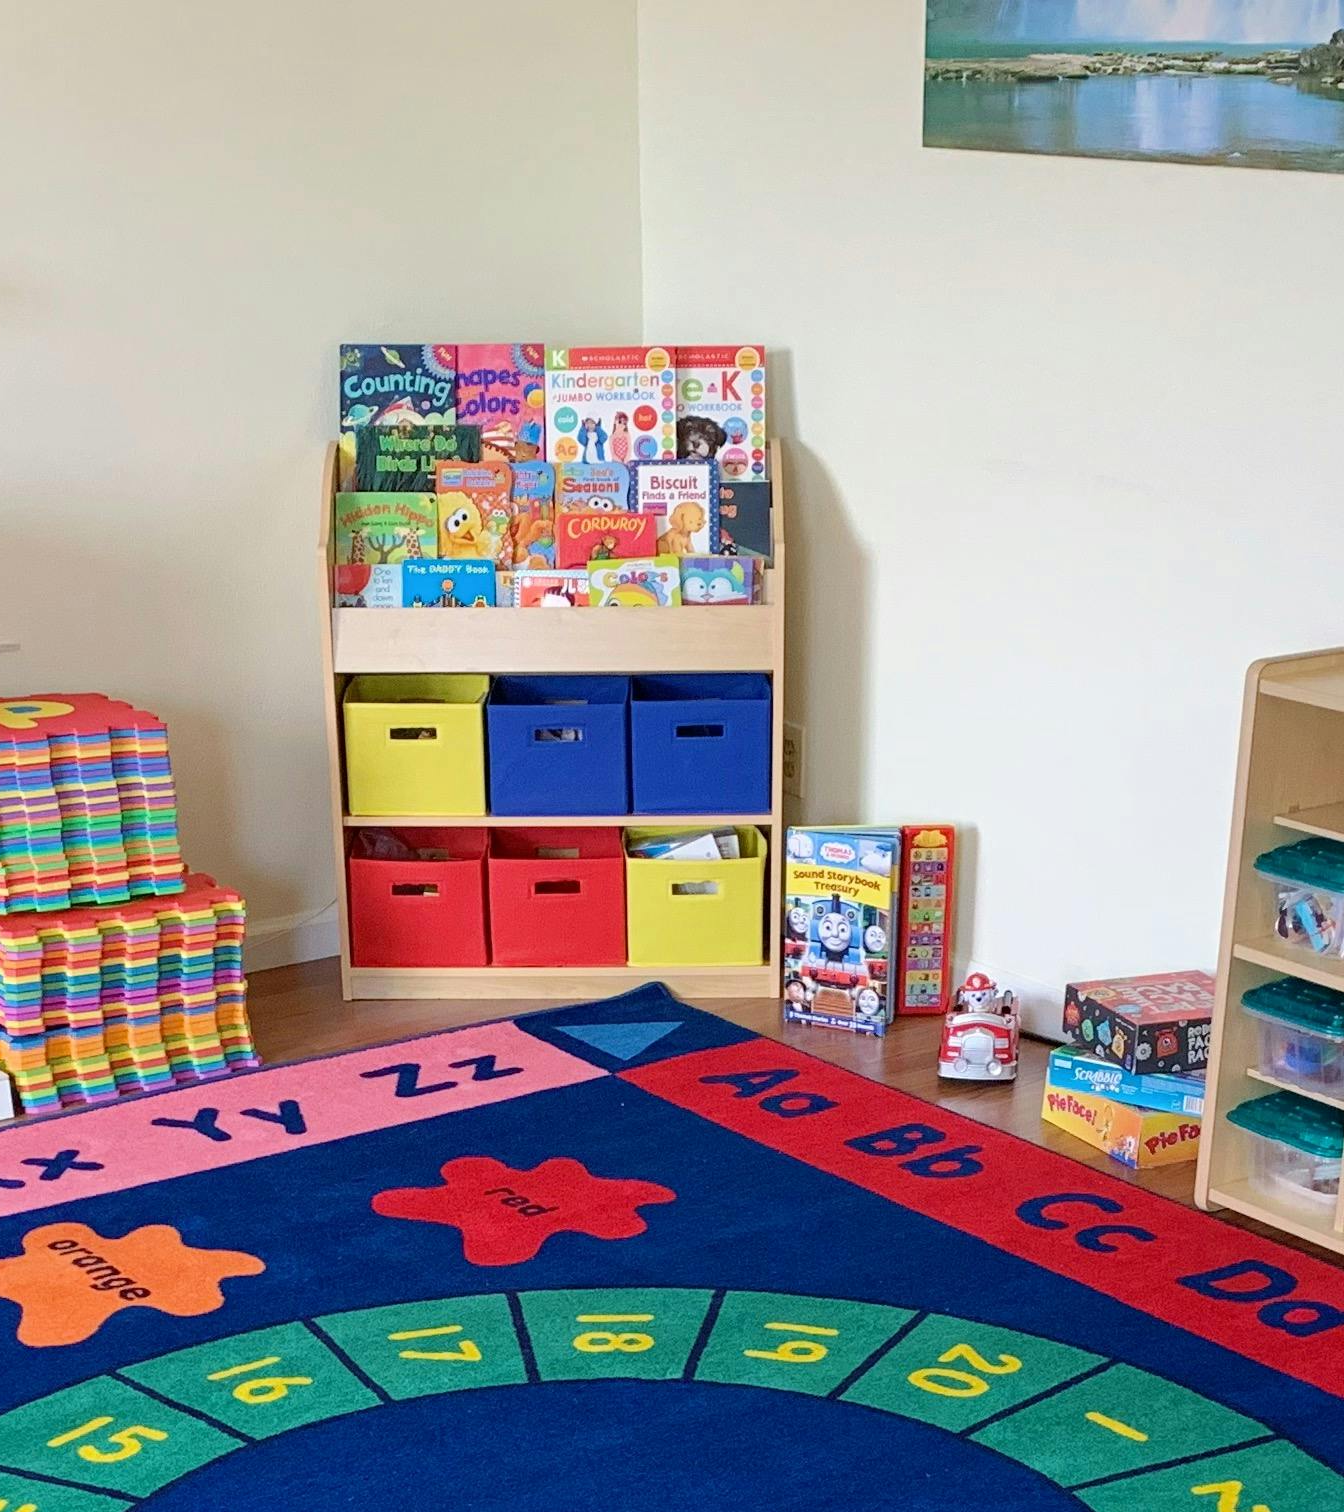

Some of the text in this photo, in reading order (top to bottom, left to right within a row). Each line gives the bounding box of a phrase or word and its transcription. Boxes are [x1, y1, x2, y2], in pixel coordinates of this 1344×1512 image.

[344, 367, 451, 407] Counting
[551, 372, 660, 391] Kindergarten
[556, 391, 656, 403] JUMBO WORKBOOK
[688, 403, 742, 411] WORKBOOK
[562, 477, 620, 492] Seasons
[642, 491, 666, 500] Finds
[678, 491, 706, 500] Friend
[650, 475, 698, 490] Biscuit
[567, 517, 647, 541] CORDUROY
[407, 565, 426, 574] The
[793, 869, 881, 891] Sound Storybook
[814, 882, 860, 896] Treasury
[1072, 1067, 1123, 1085] SCRABBLE
[152, 1100, 307, 1141] Yy
[360, 1055, 523, 1097] Zz
[700, 1069, 838, 1118] Aa
[845, 1124, 983, 1178] Bb
[1016, 1193, 1156, 1253] Cc
[484, 1184, 556, 1220] red
[47, 1237, 152, 1302] orange
[392, 1326, 480, 1360] 17
[575, 1315, 653, 1351] 18
[748, 1323, 836, 1362] 19
[214, 1358, 308, 1403] 16
[909, 1345, 1020, 1396] 20
[51, 1417, 165, 1462] 15
[1088, 1413, 1146, 1440] 1
